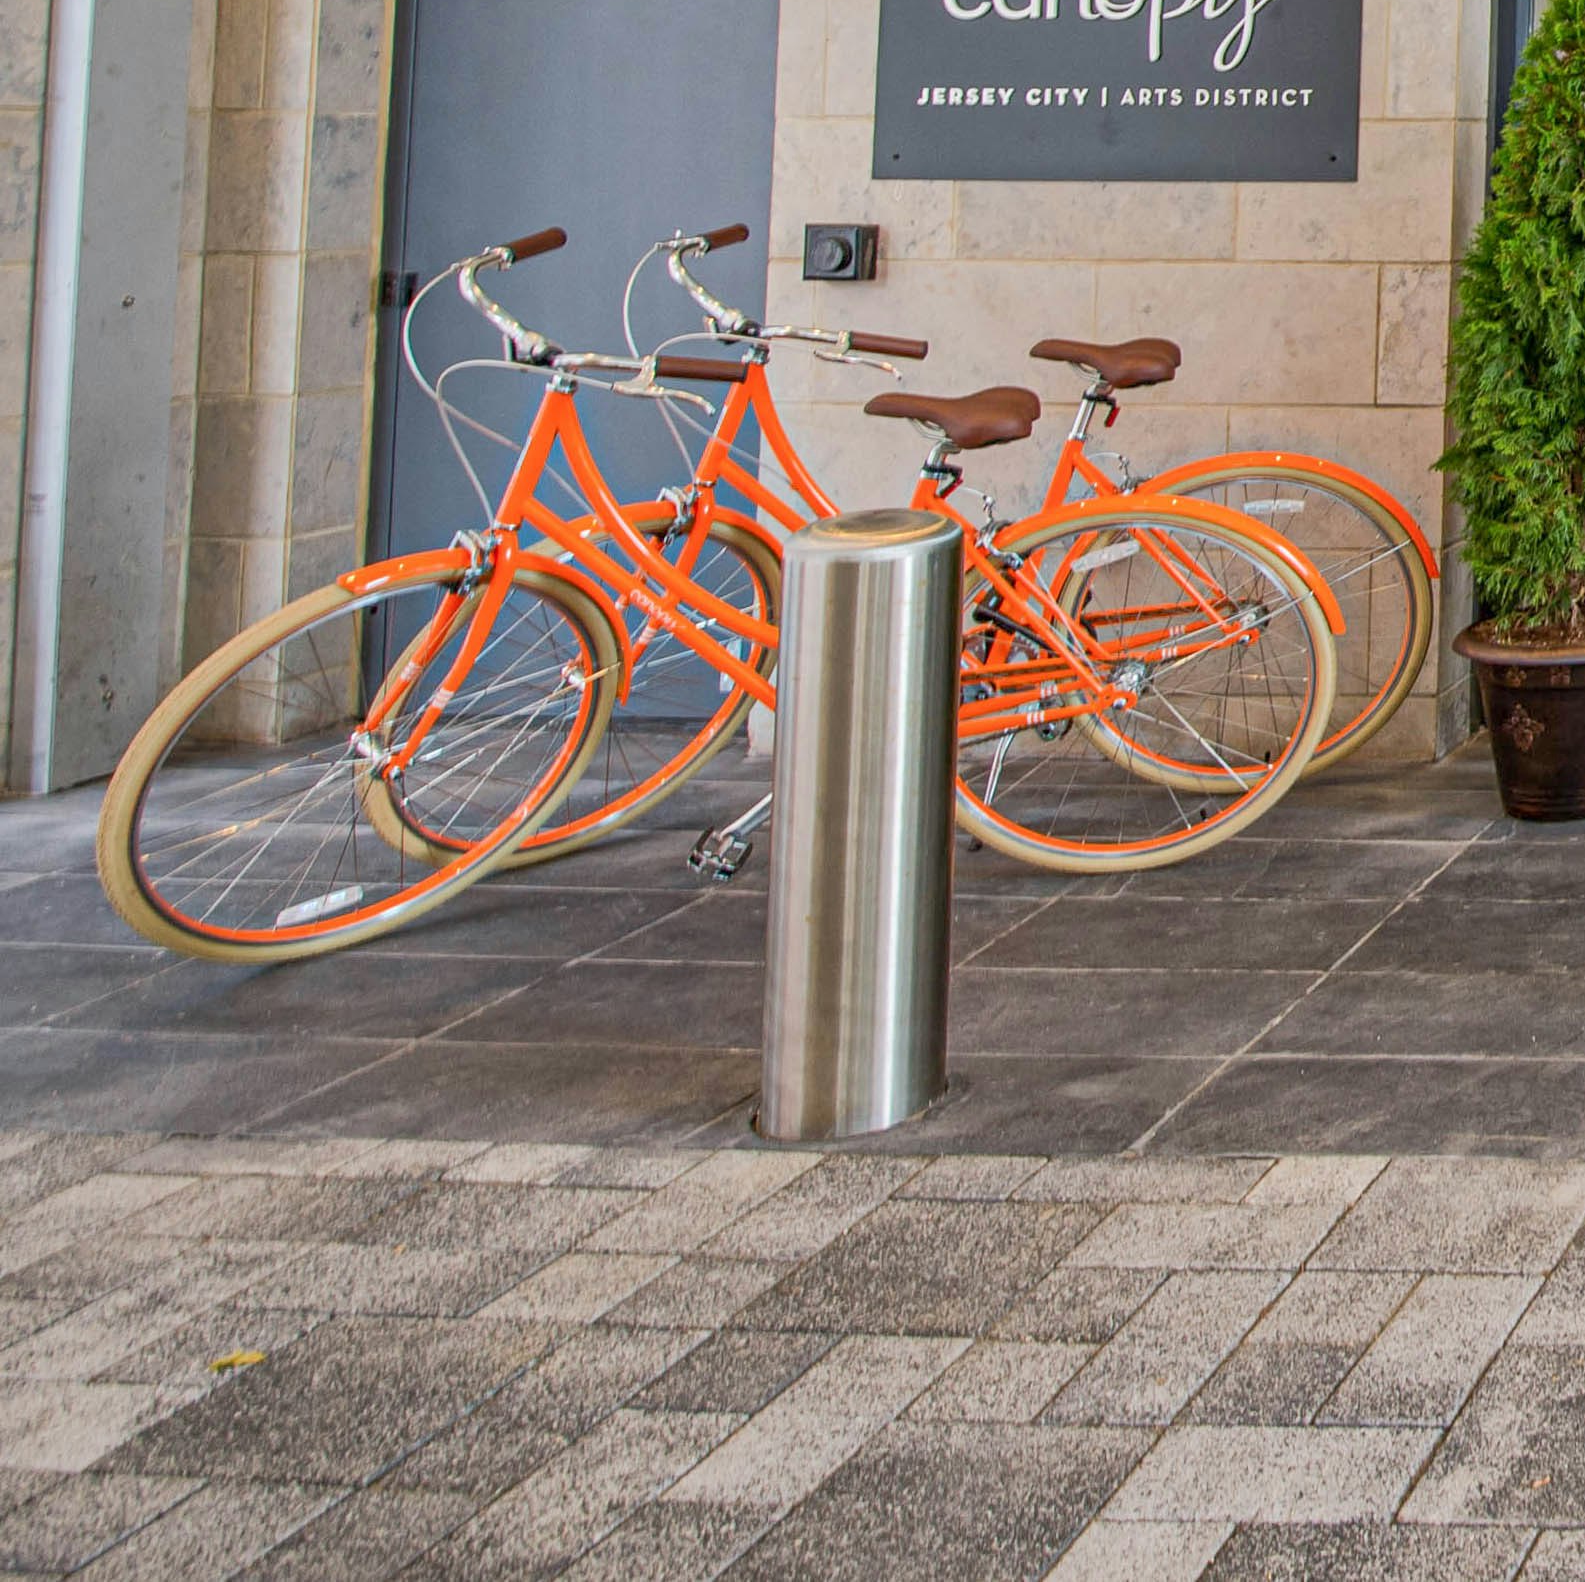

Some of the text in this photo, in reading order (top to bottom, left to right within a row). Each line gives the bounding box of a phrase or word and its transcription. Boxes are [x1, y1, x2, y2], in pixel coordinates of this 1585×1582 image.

[916, 87, 1015, 107] JERSEY
[1025, 87, 1090, 107] CITY
[1119, 87, 1184, 107] ARTS
[1194, 88, 1314, 108] DISTRICT
